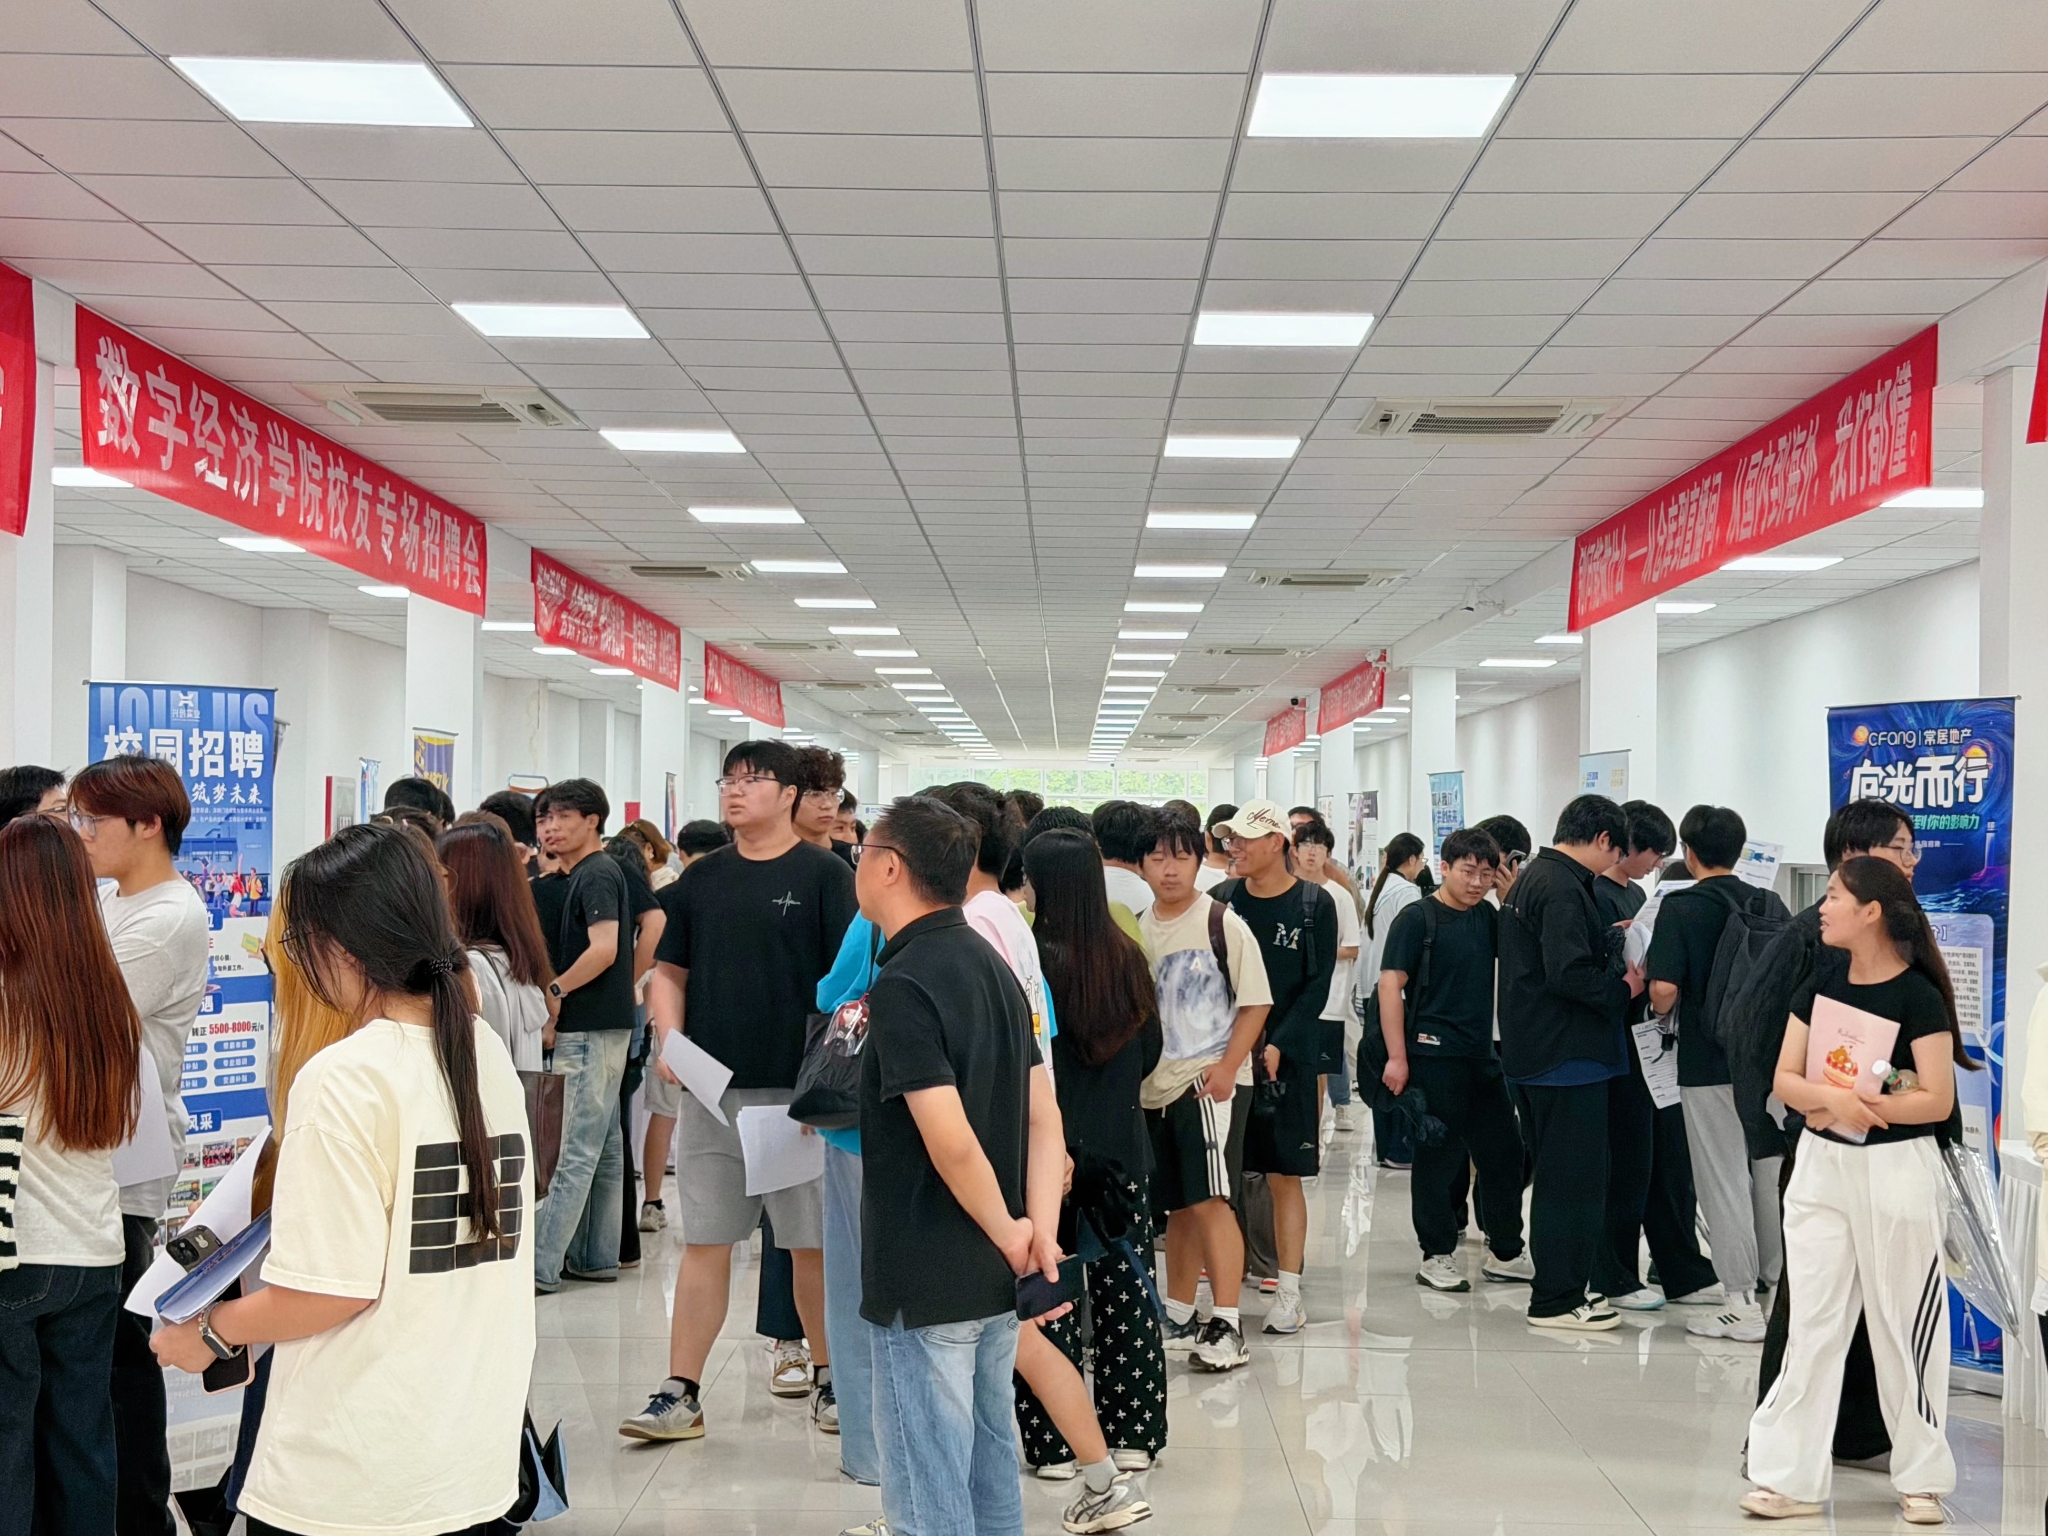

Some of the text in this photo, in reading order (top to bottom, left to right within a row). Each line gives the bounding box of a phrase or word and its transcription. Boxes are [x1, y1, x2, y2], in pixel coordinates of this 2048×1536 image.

[96, 335, 482, 596] 数字经济学院校友专场招聘会
[1923, 728, 1973, 746] 常居地产
[102, 725, 264, 779] 校园招聘
[191, 781, 263, 805] 筑梦未来
[1849, 755, 1990, 808] 向光而行
[1910, 814, 1980, 830] 到你的影响力
[1189, 956, 1203, 971] A
